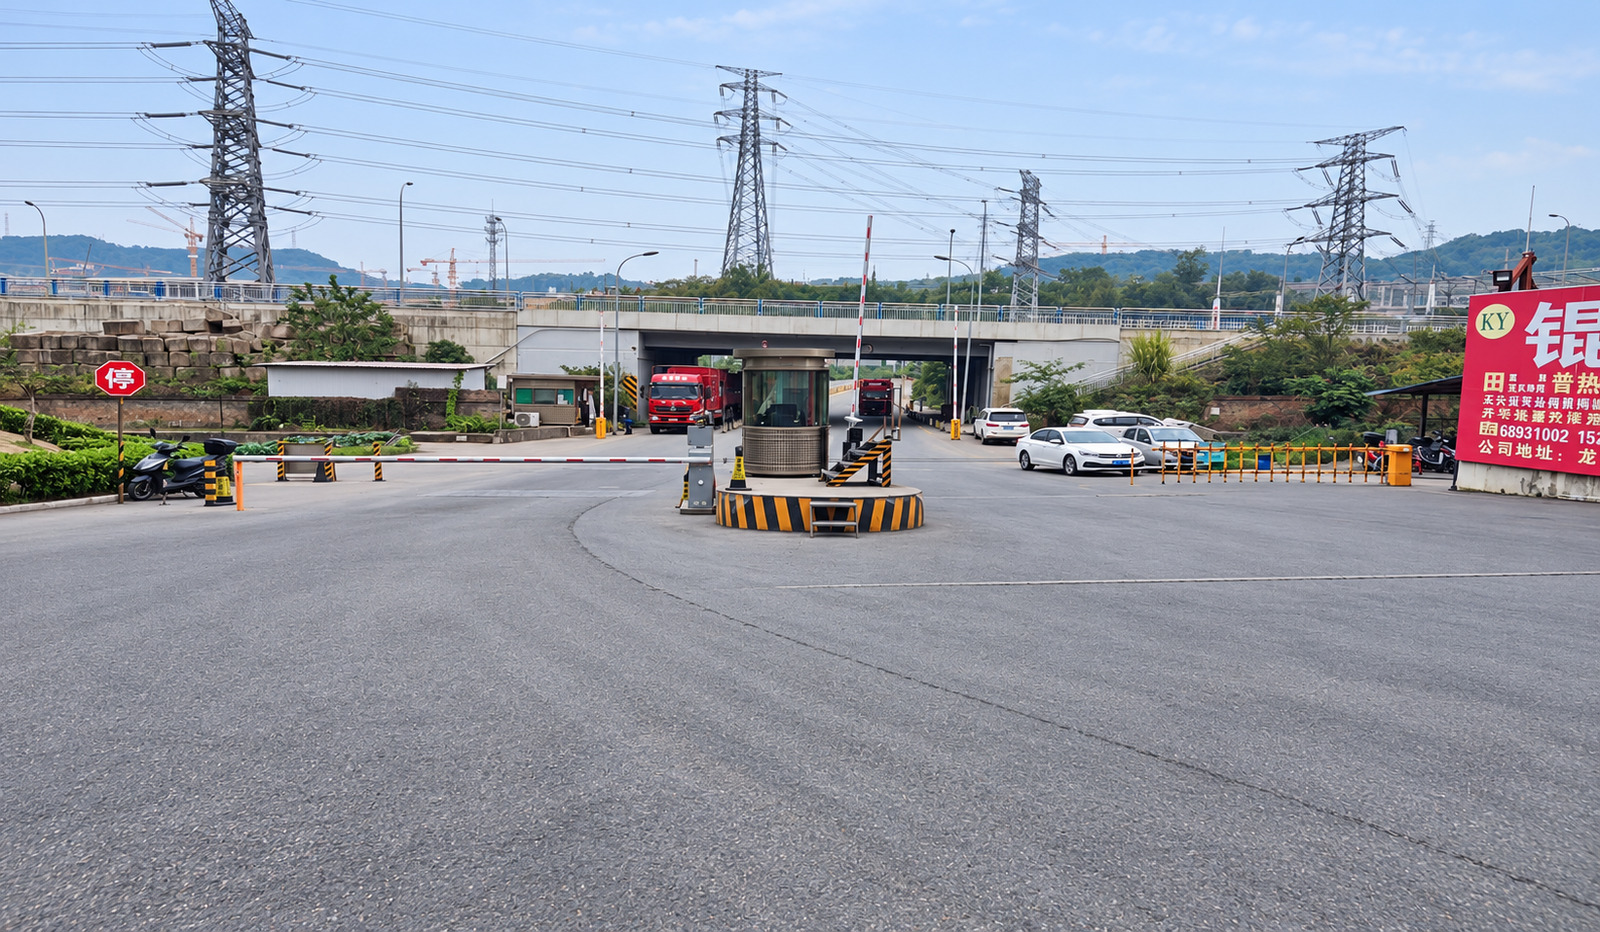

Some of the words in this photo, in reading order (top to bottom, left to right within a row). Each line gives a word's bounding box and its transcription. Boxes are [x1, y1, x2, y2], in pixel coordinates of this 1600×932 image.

[1481, 311, 1509, 331] KY
[104, 367, 135, 389] 停
[1500, 424, 1569, 443] 68931002
